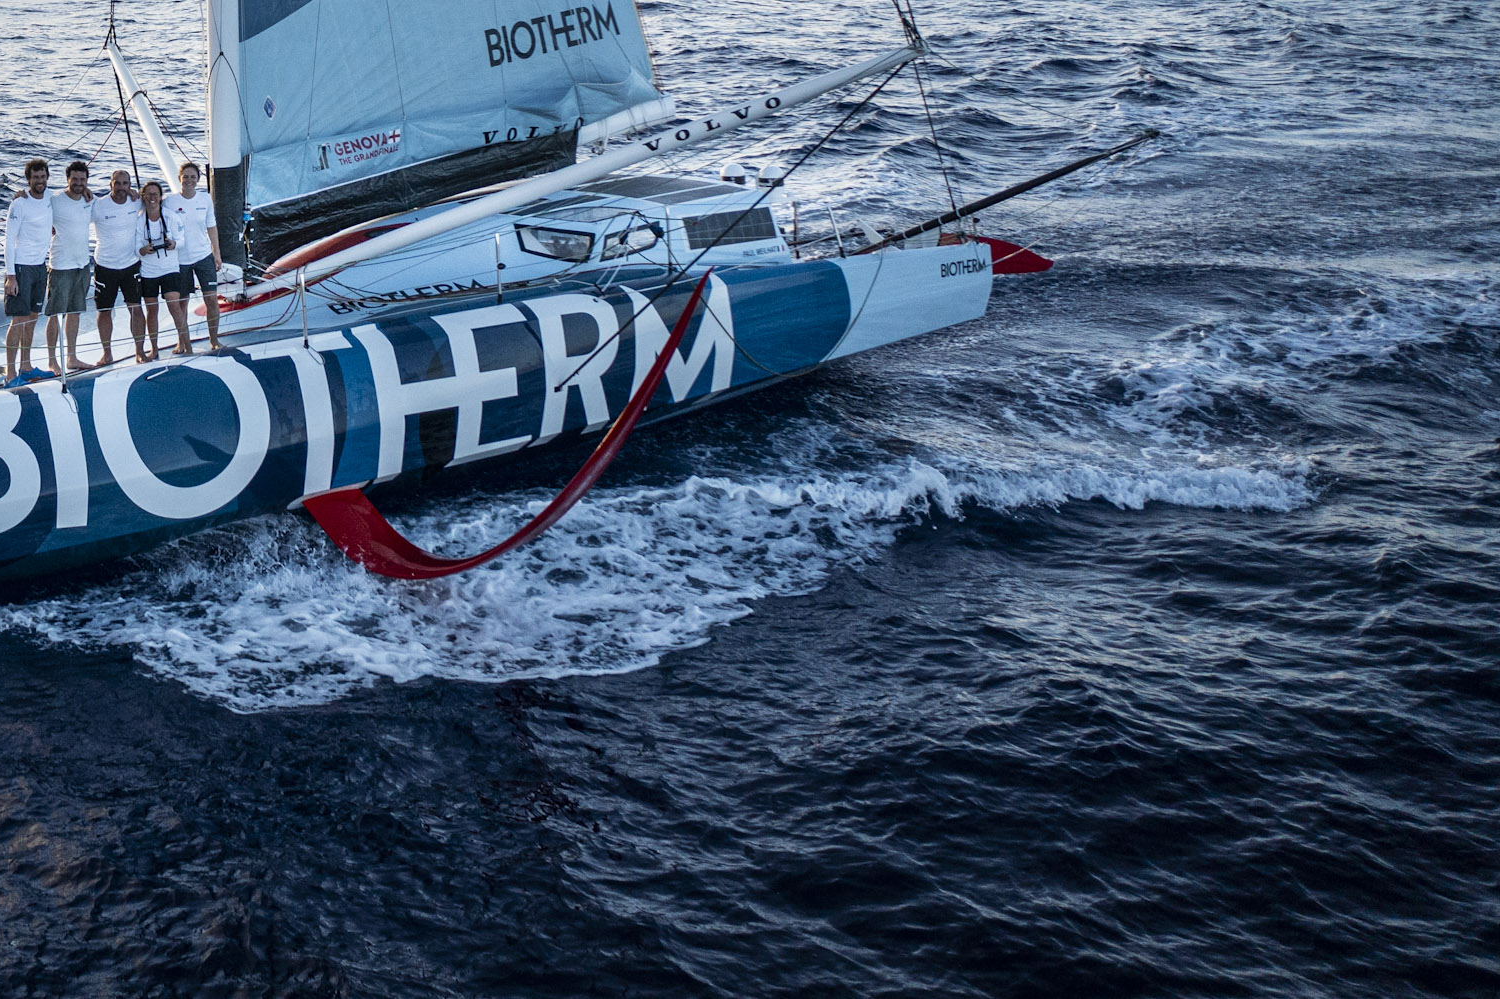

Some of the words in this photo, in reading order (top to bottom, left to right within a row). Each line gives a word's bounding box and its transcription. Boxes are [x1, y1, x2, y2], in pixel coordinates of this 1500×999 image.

[484, 0, 621, 68] BIOTHERM
[334, 132, 388, 156] GENOVA
[642, 96, 782, 152] VOLVO
[338, 156, 353, 166] THE
